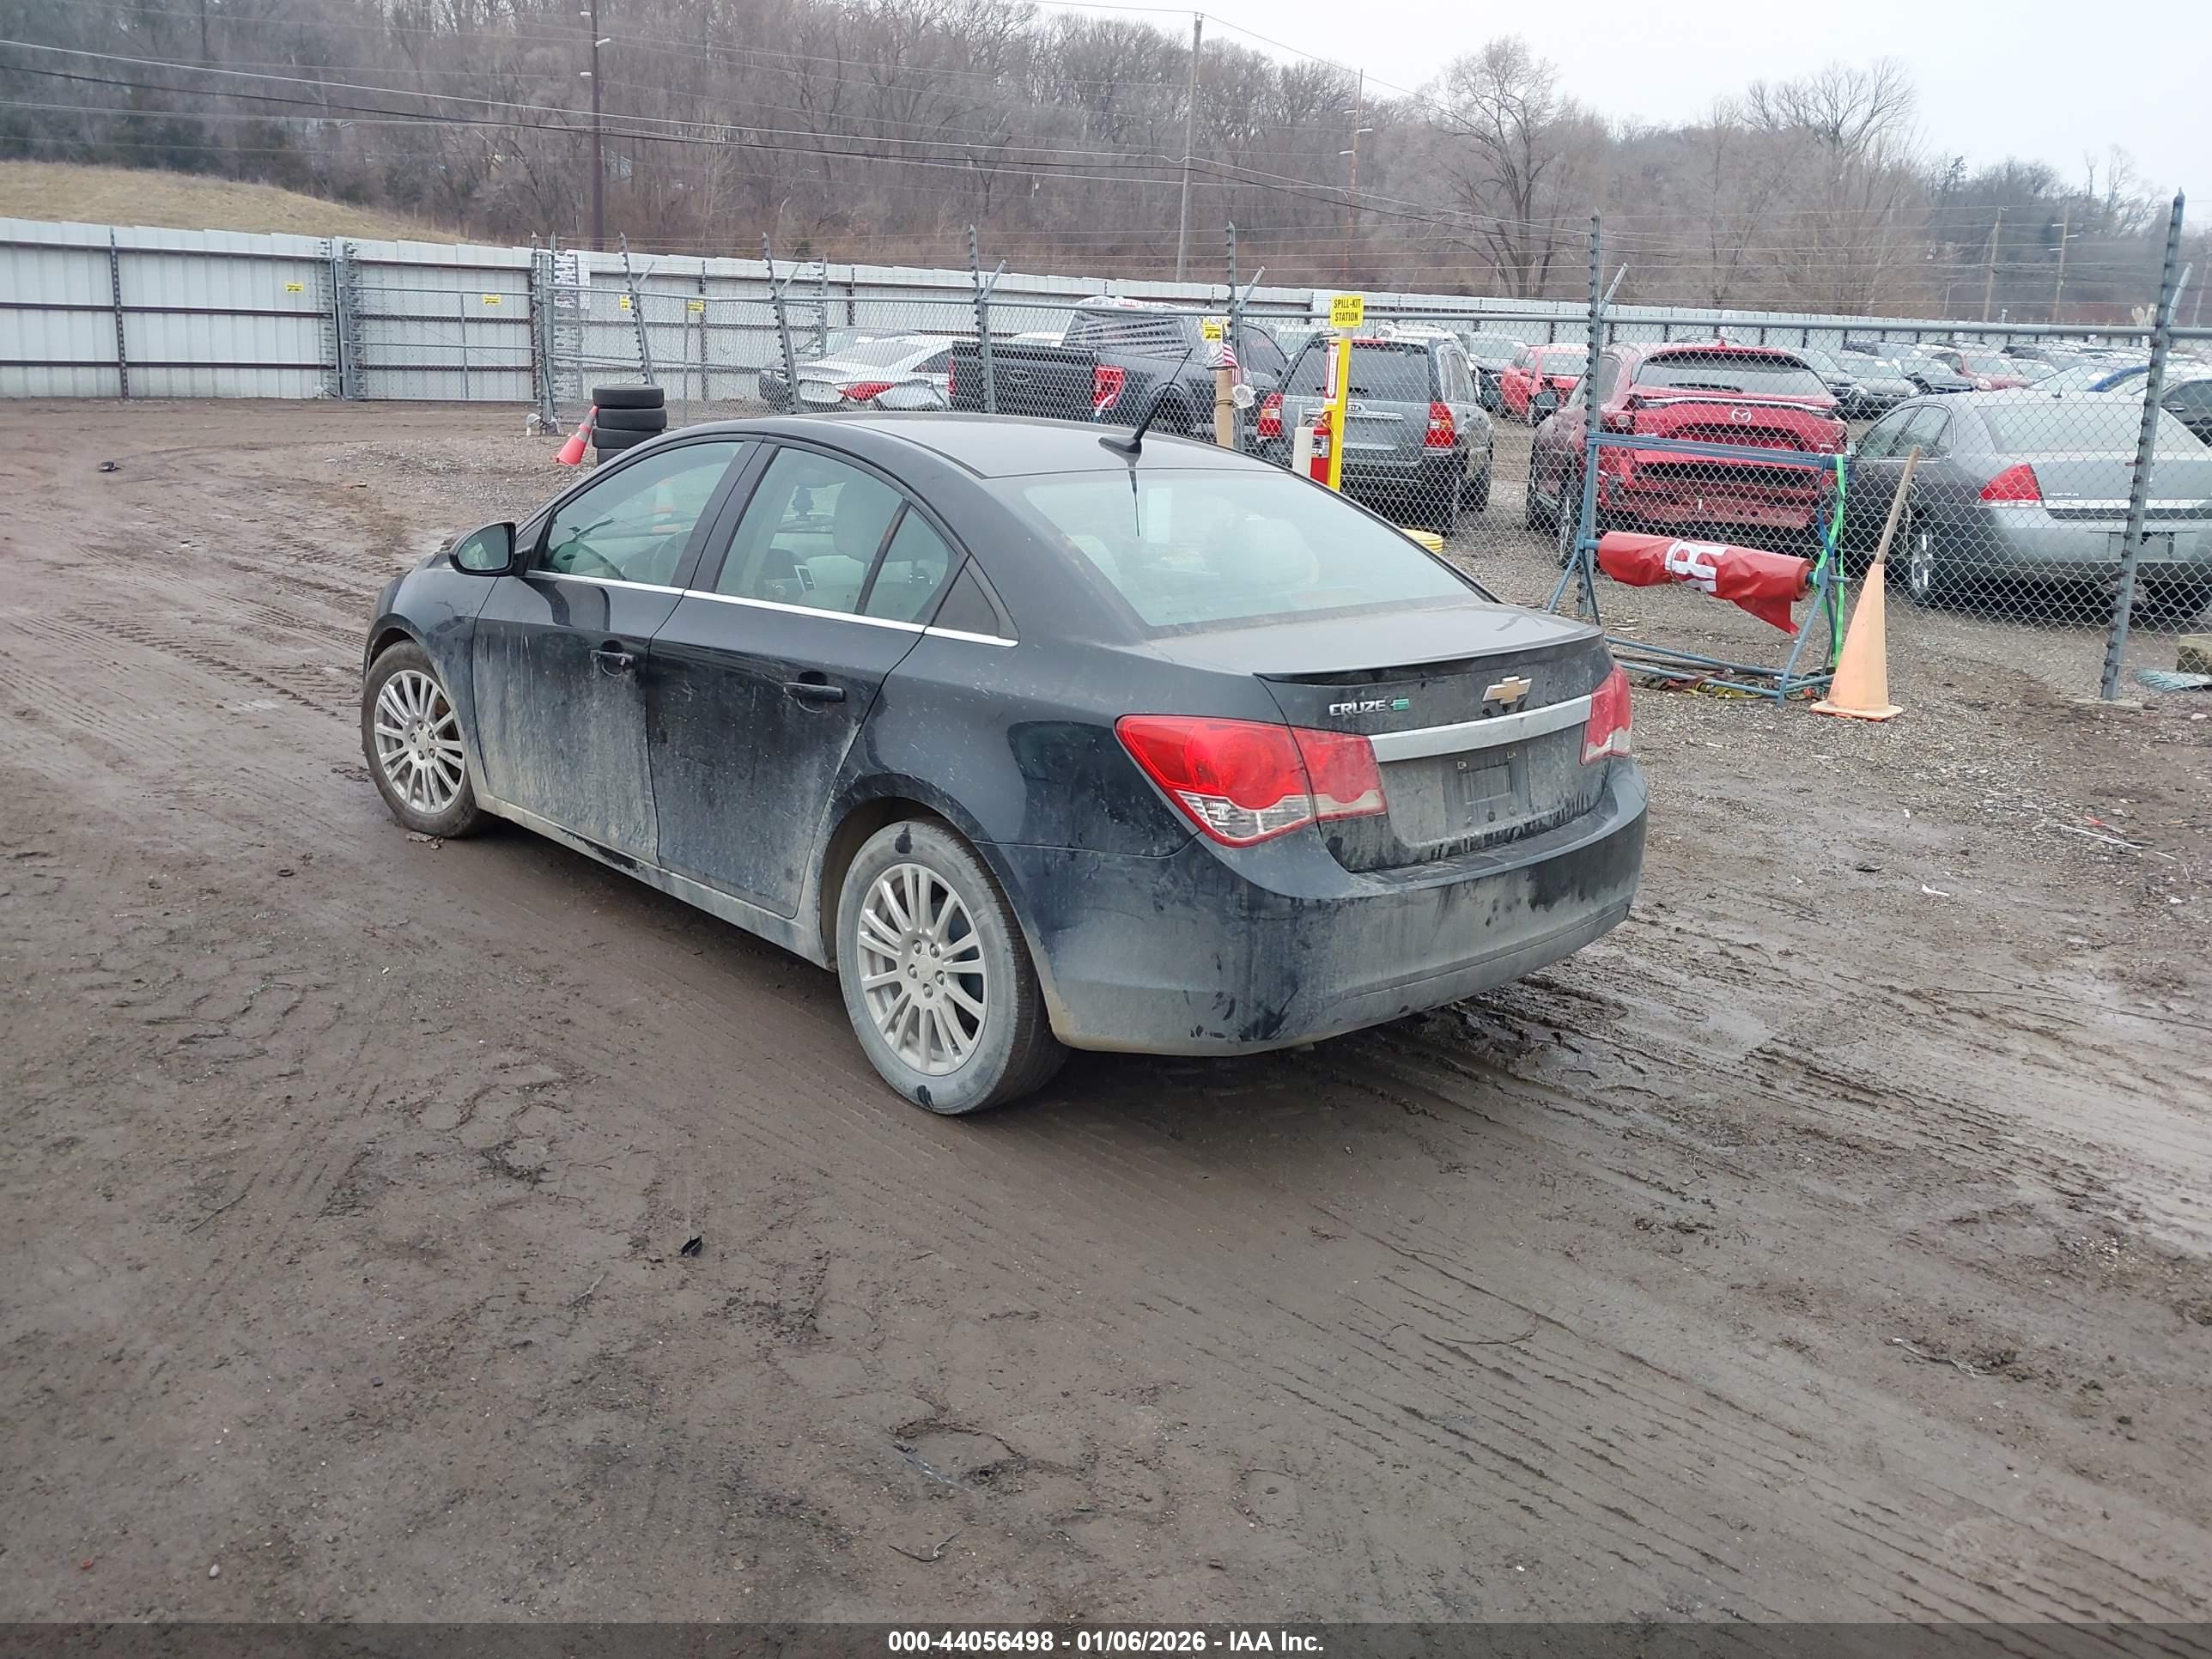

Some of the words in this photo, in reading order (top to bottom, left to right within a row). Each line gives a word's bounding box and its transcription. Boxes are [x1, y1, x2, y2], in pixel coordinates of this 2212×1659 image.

[1334, 298, 1361, 309] SPILL-KIT
[1334, 312, 1358, 322] STATION
[1328, 699, 1386, 716] CRUZE
